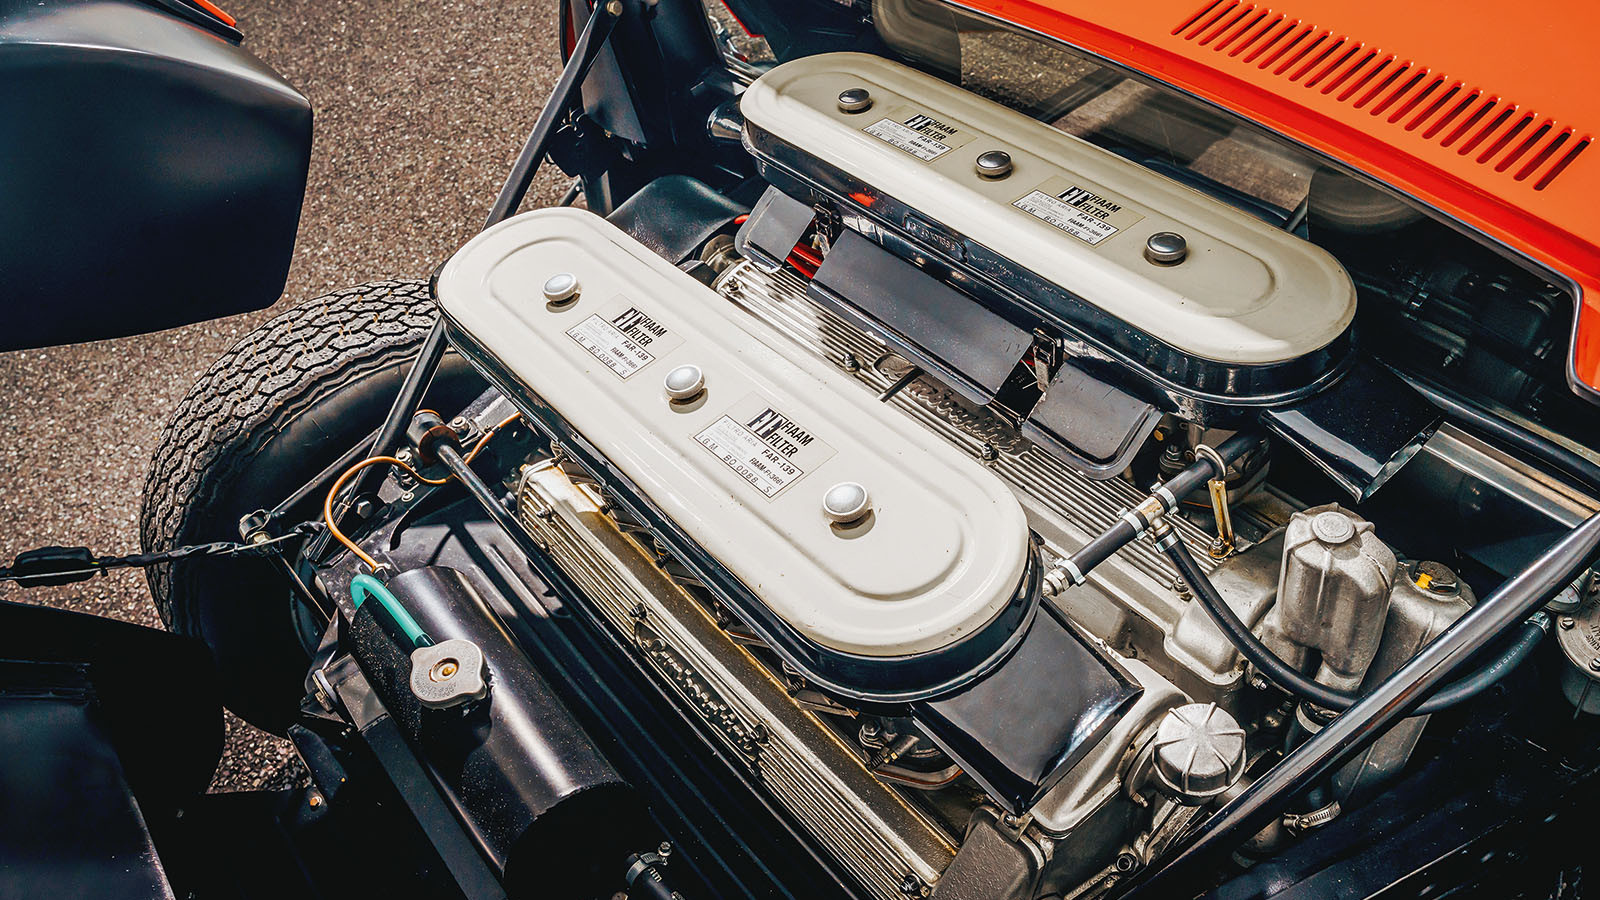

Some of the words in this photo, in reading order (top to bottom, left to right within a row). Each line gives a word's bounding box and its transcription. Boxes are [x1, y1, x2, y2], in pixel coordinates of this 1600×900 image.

[922, 127, 947, 141] FILTER
[933, 120, 958, 135] FIAAM
[918, 135, 946, 150] FAR-139
[1078, 202, 1110, 220] FILTER
[1090, 195, 1122, 213] FIAAM
[1077, 213, 1111, 231] FAR-139
[627, 326, 653, 347] FILTER
[641, 317, 667, 338] FIAAM
[622, 340, 649, 361] FAR-139
[781, 422, 814, 447] FIAAM
[723, 420, 742, 436] FILTRO
[743, 434, 757, 447] ARIA
[761, 449, 795, 476] FAR-139
[766, 433, 798, 458] FILTER
